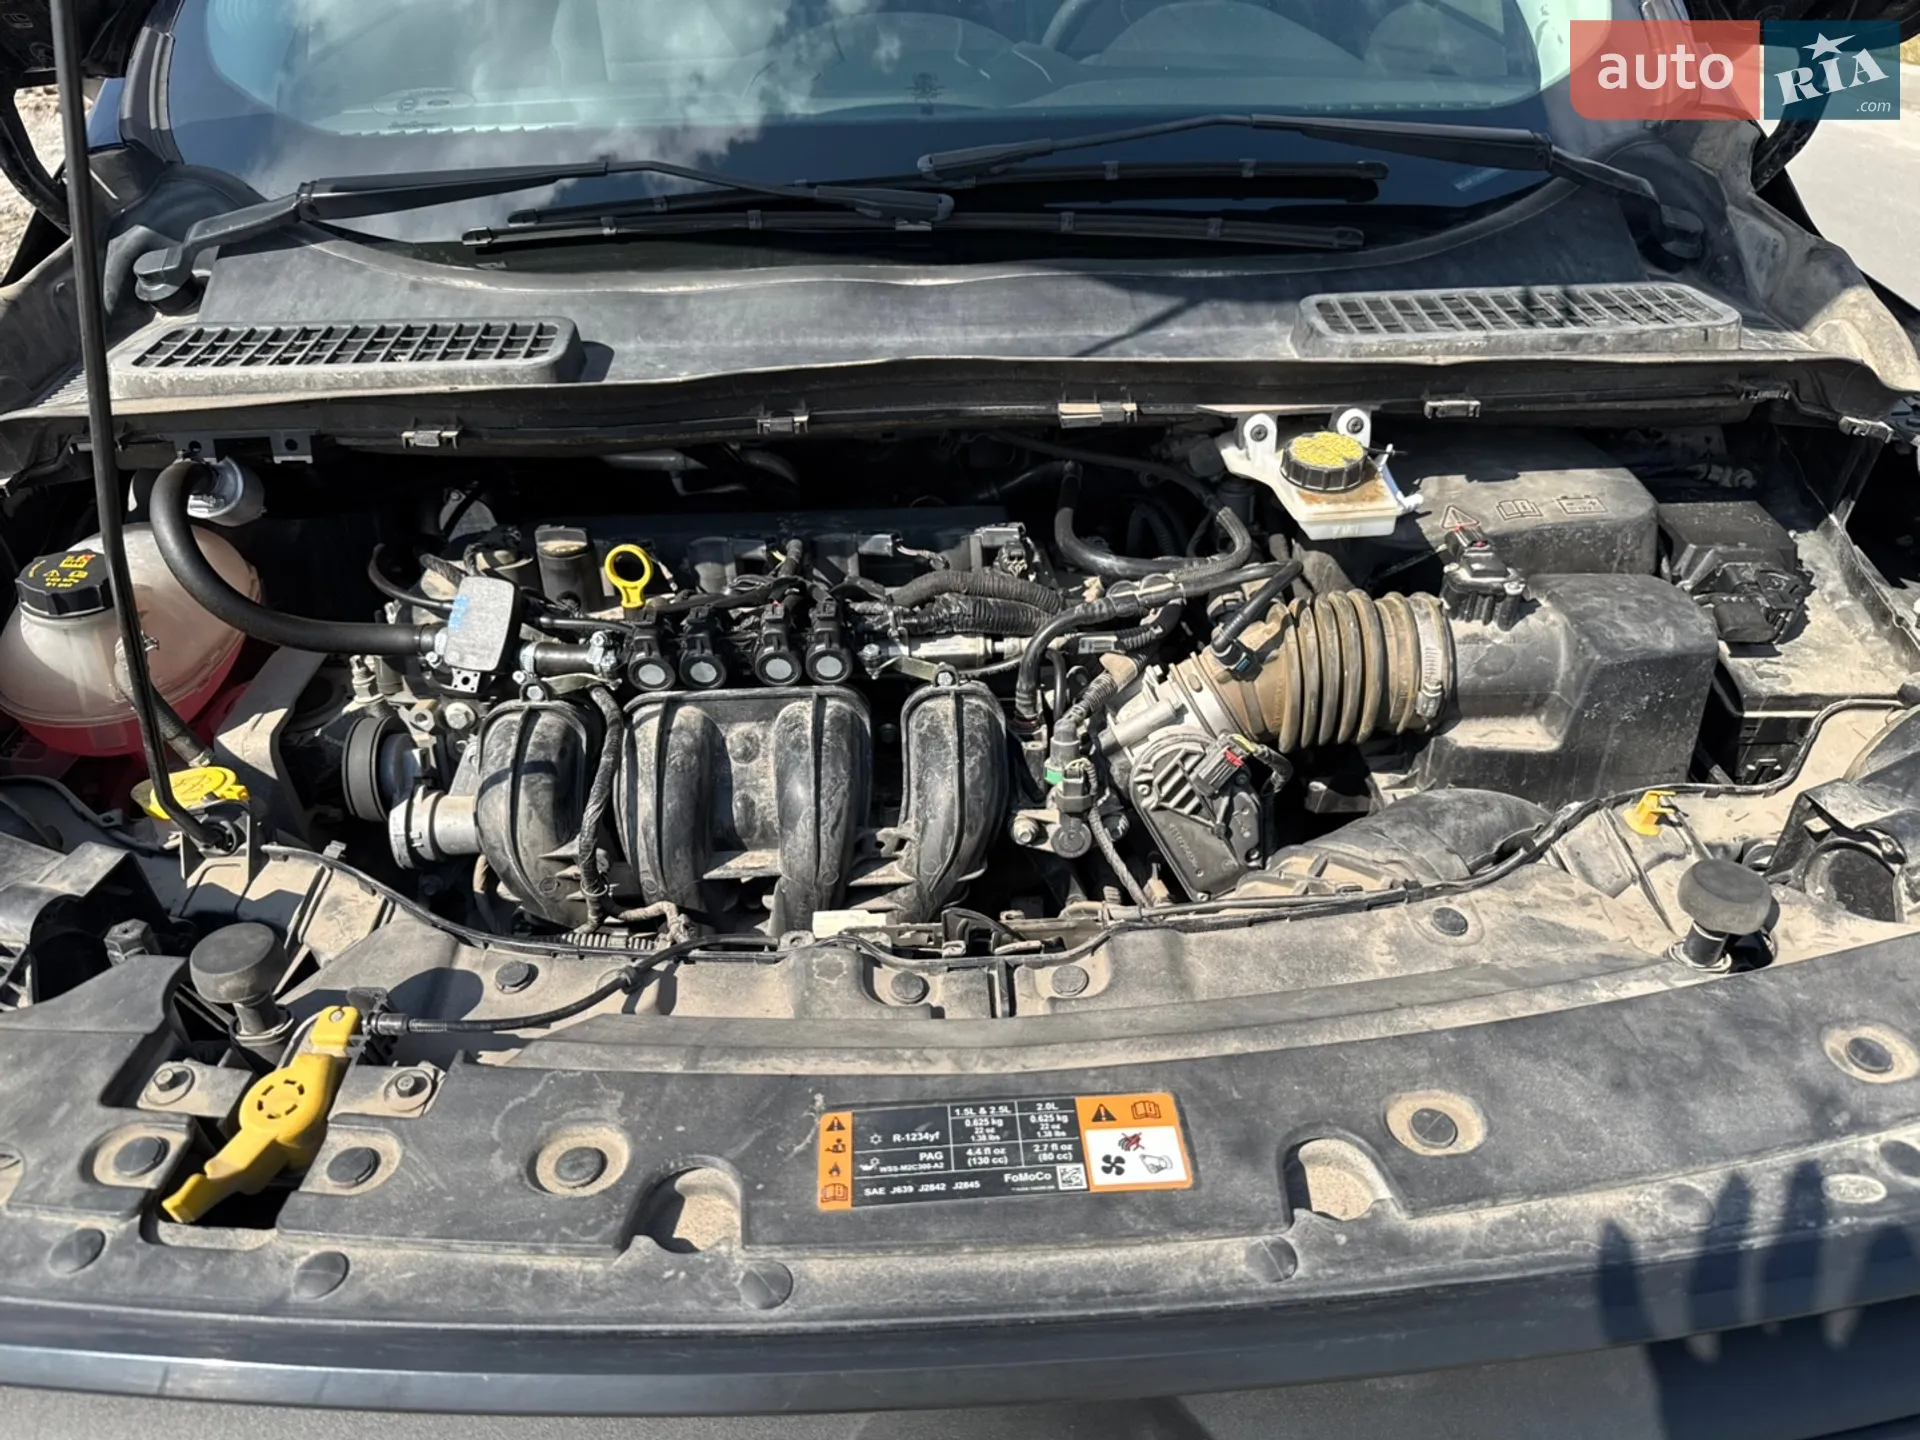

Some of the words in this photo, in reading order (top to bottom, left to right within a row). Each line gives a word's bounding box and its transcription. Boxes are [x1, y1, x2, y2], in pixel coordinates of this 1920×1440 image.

[955, 1107, 976, 1116] 1.5L
[979, 1107, 987, 1115] &
[989, 1105, 1011, 1114] 2.5L
[1036, 1102, 1059, 1111] 2.0L
[964, 1118, 989, 1127] 0.625
[991, 1118, 1004, 1127] kg
[1030, 1114, 1054, 1123] 0.625
[1056, 1114, 1068, 1123] kg
[892, 1131, 940, 1143] R-1234yf
[966, 1147, 982, 1156] 4.4
[983, 1147, 991, 1155] fl
[1033, 1144, 1048, 1153] 2.7
[1050, 1143, 1059, 1151] fl
[919, 1151, 944, 1161] PAG
[967, 1156, 990, 1167] (130
[991, 1155, 1008, 1165] cc)
[1038, 1152, 1054, 1162] (80
[1056, 1152, 1073, 1162] cc)
[1004, 1171, 1052, 1183] FoMoCo
[864, 1187, 886, 1196] SAE
[890, 1185, 914, 1194] J639
[918, 1183, 946, 1192] J2842
